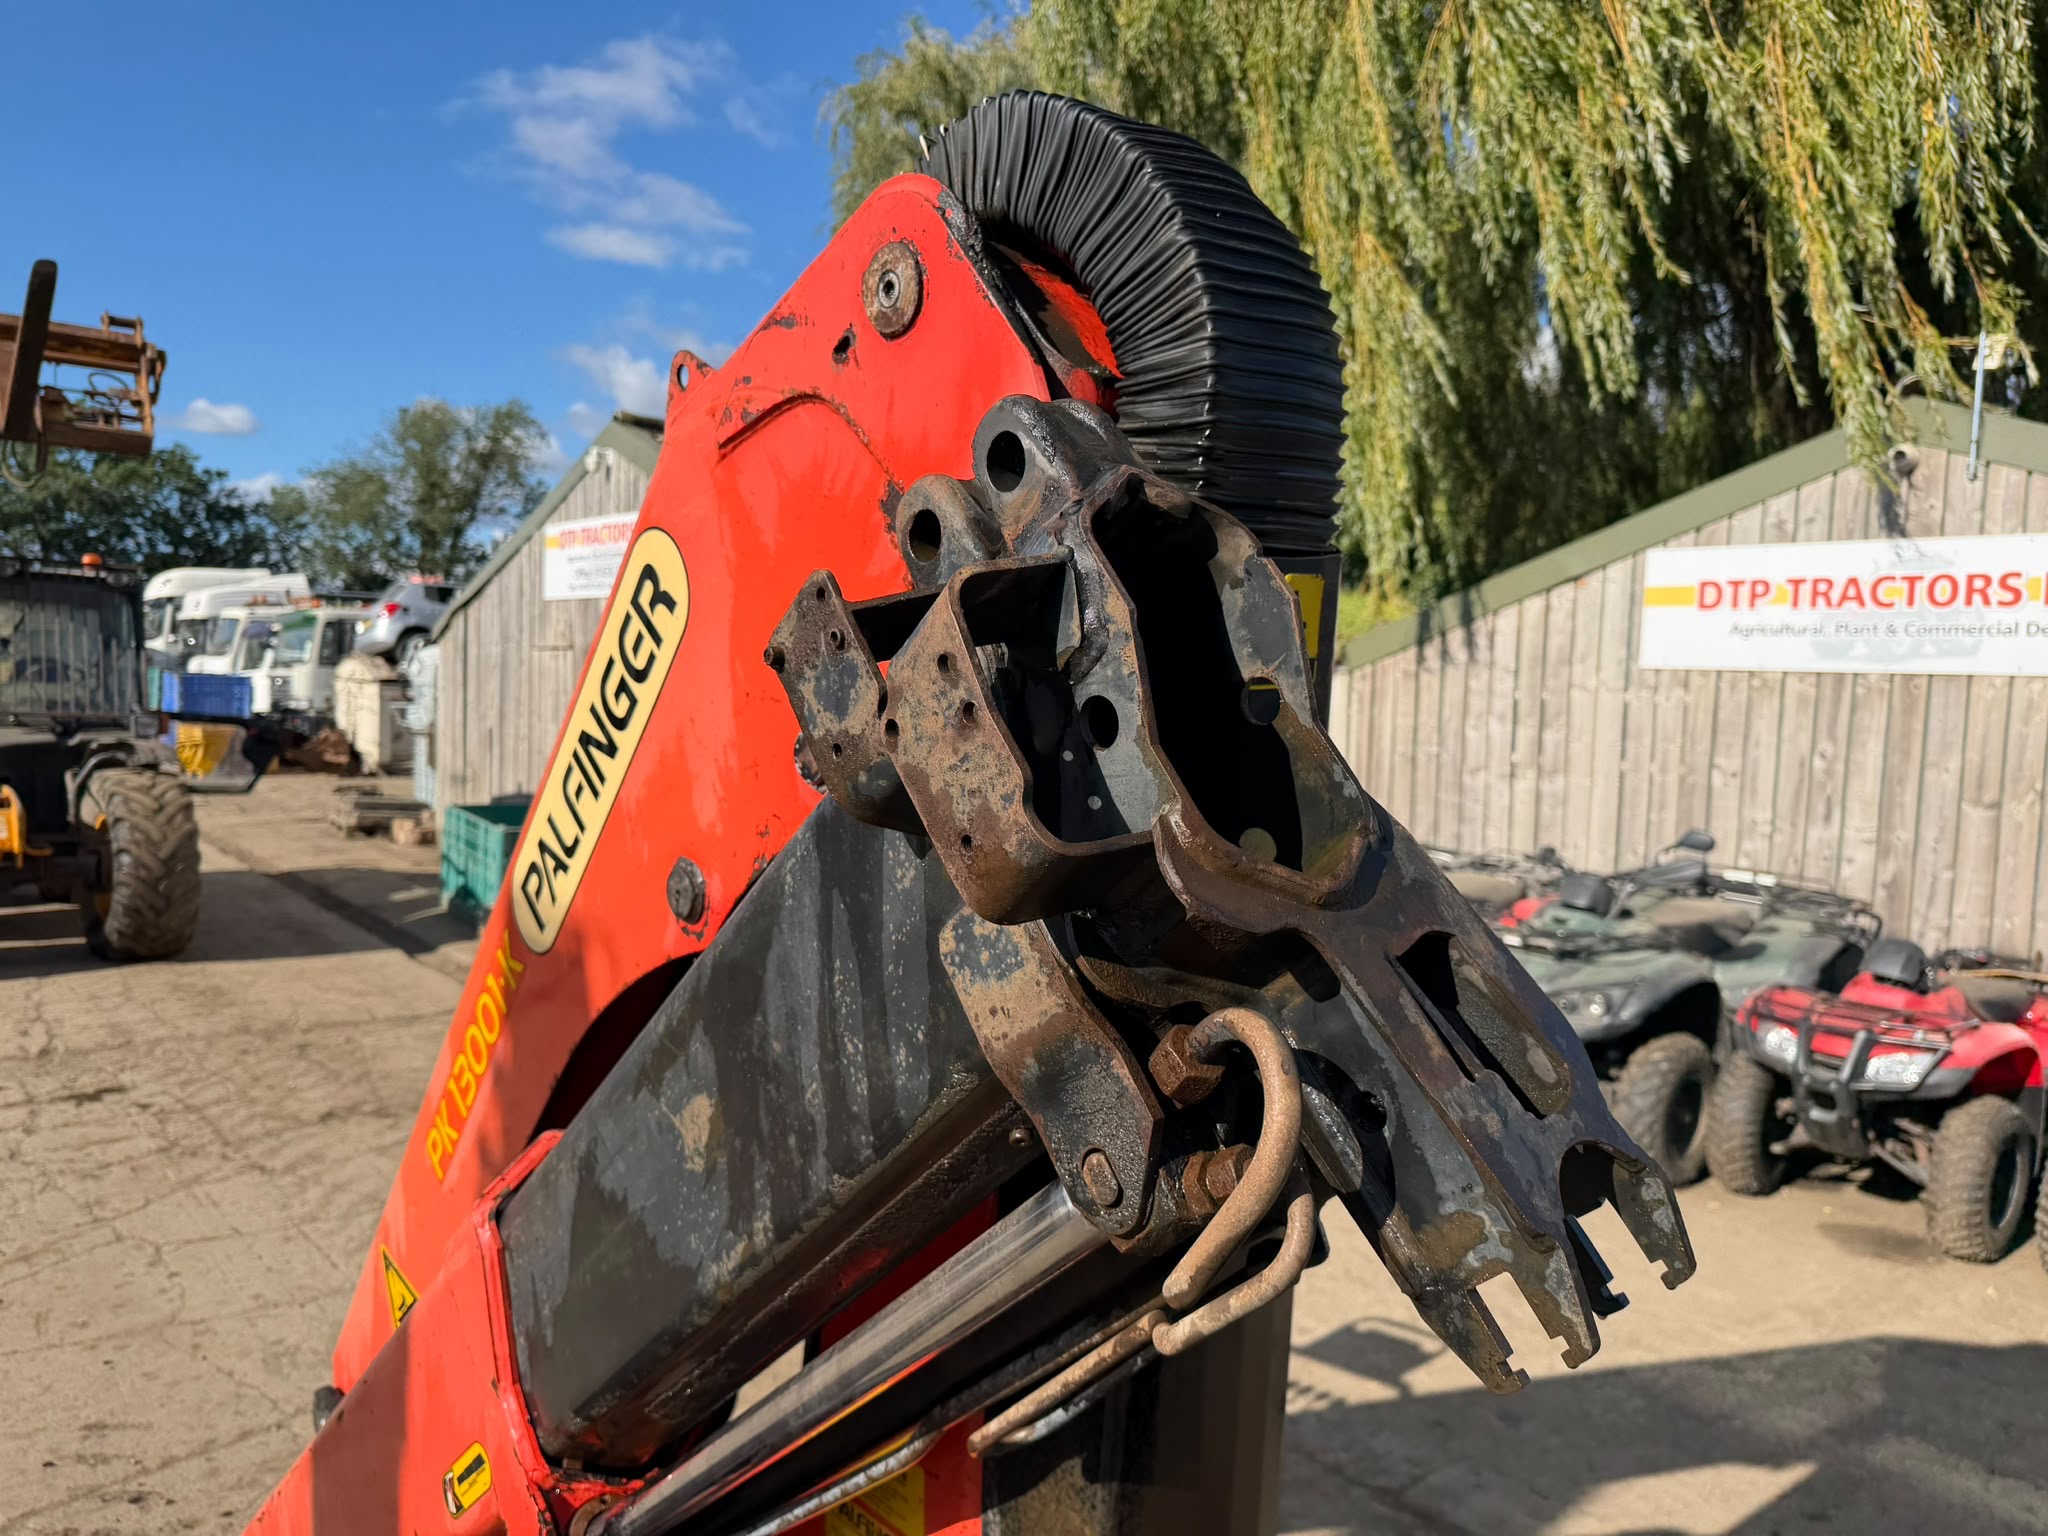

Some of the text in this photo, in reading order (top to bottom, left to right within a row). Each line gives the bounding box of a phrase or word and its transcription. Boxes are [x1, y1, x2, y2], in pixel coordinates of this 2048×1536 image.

[1698, 579, 1771, 611] DTP
[1786, 572, 2023, 609] TRACTORS
[1835, 621, 1879, 637] Plant
[1885, 622, 1898, 638] &
[1904, 620, 2019, 638] Commercial
[521, 563, 677, 934] PALFINGER
[426, 1100, 459, 1180] PK
